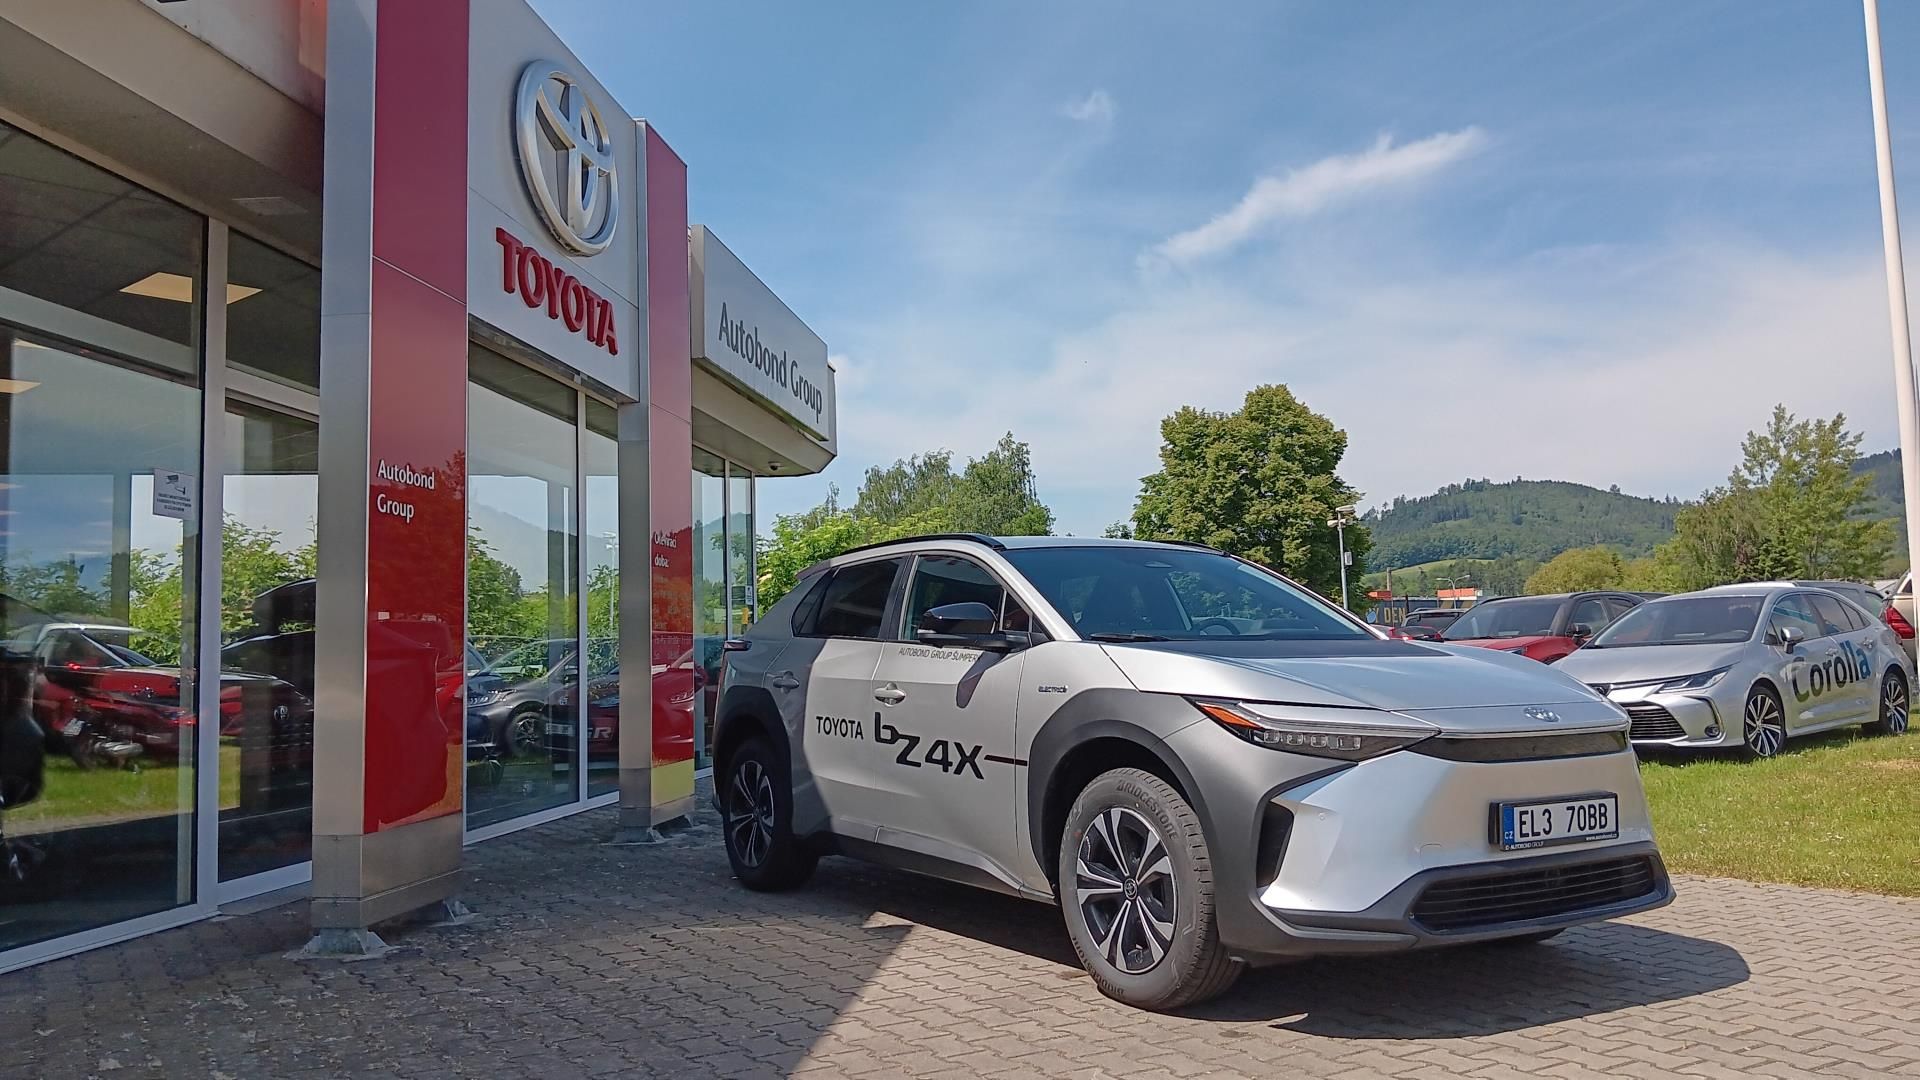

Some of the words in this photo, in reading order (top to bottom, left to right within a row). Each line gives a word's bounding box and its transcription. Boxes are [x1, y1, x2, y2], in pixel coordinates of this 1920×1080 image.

[495, 227, 619, 356] TOYOTA
[719, 301, 788, 390] Autobond
[791, 360, 825, 424] Group
[378, 459, 435, 491] Autobond
[377, 493, 415, 523] Group
[898, 647, 931, 658] AUTOBOND
[930, 649, 953, 660] GROUP
[1791, 640, 1872, 703] Corolla
[816, 715, 864, 741] TOYOTA
[1504, 830, 1514, 840] CZ
[1519, 808, 1552, 839] EL3
[1566, 802, 1608, 833] 70BB
